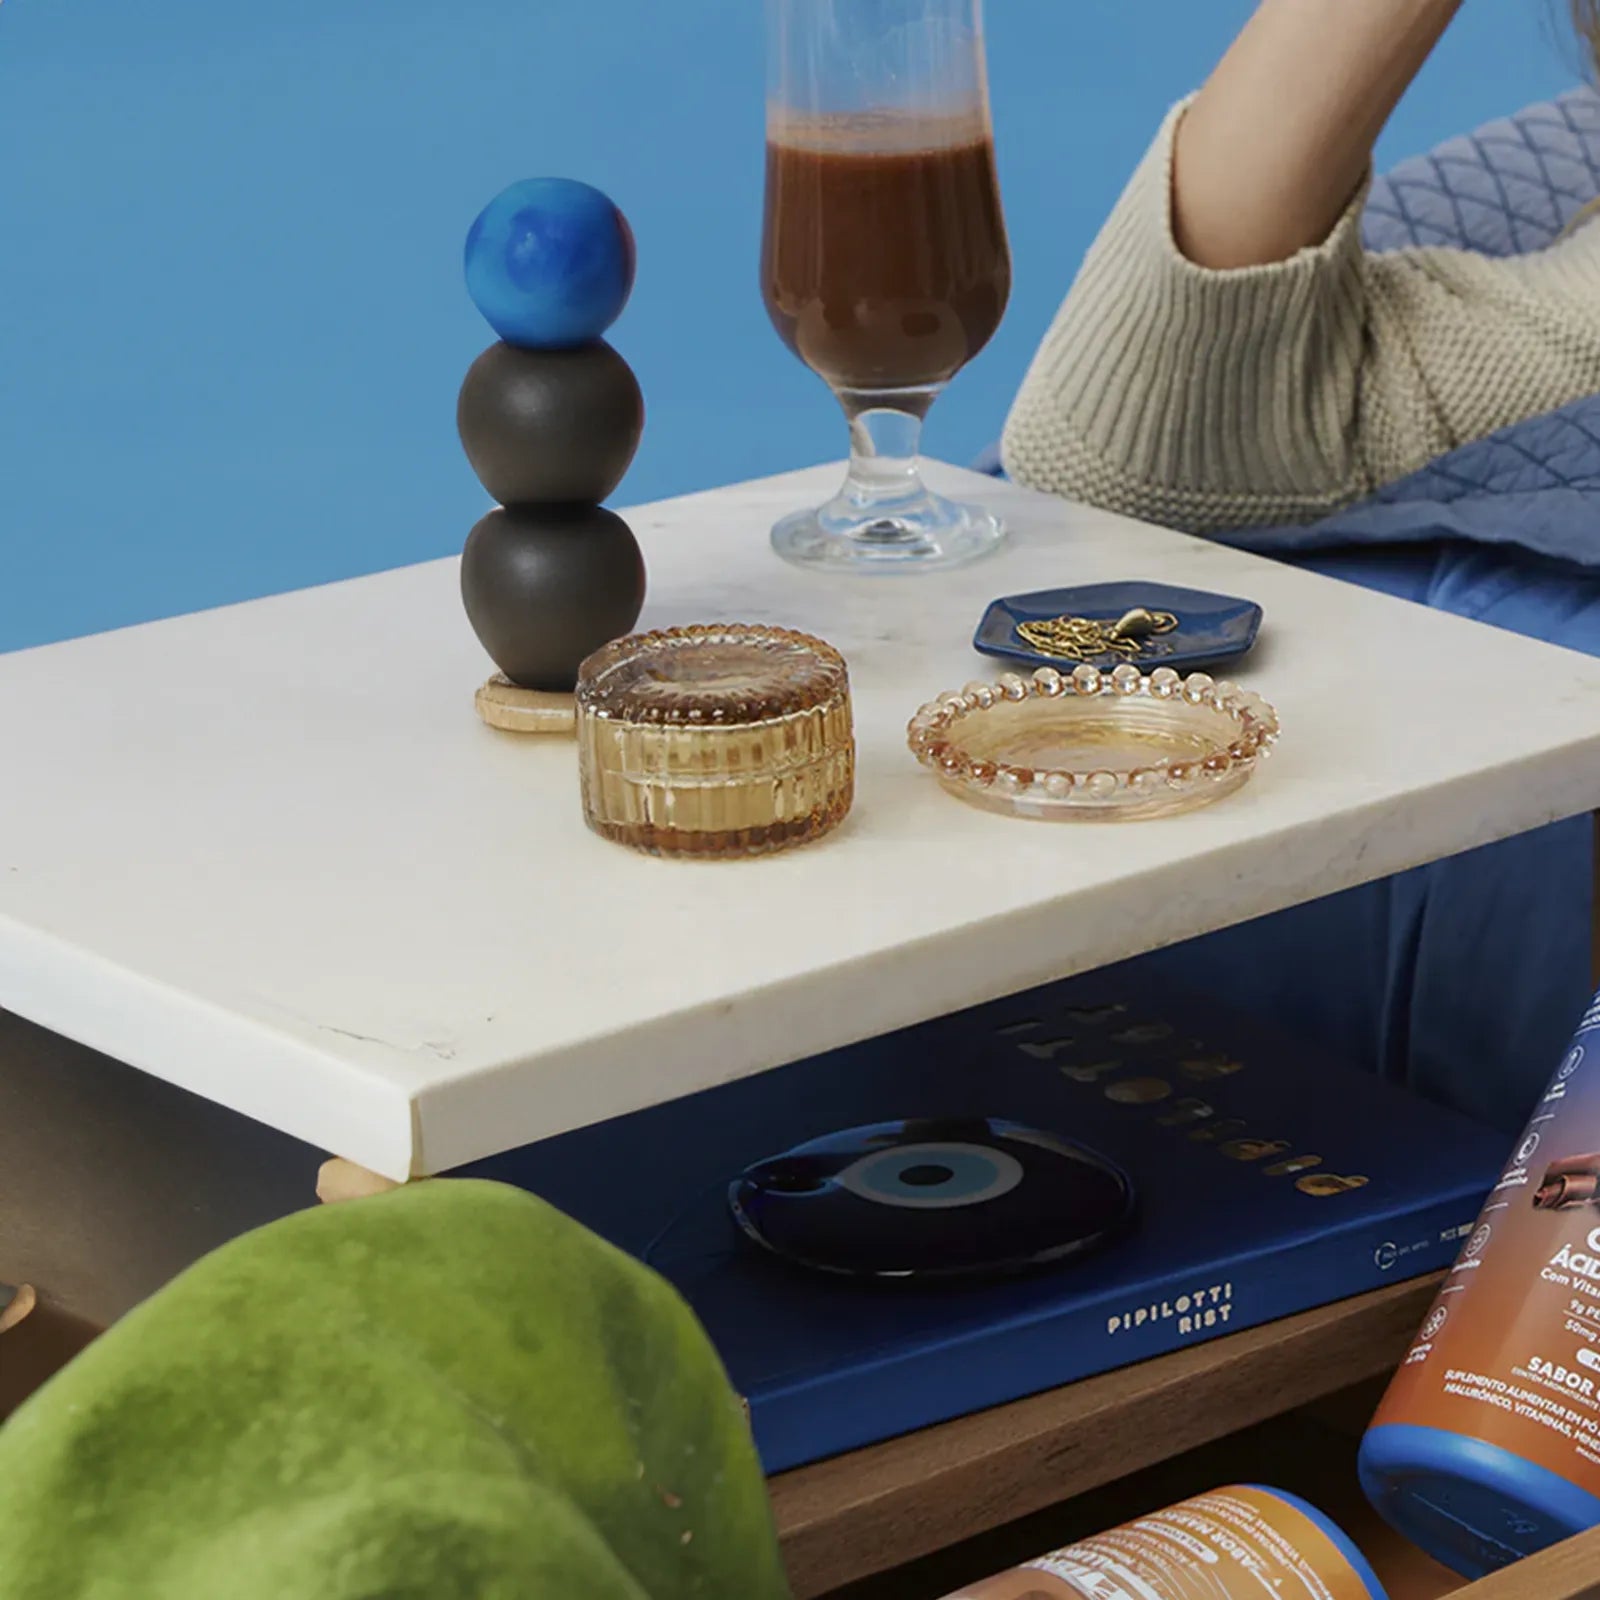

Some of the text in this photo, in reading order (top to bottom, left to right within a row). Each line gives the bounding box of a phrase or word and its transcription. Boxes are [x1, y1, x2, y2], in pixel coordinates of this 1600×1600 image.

[1540, 1266, 1570, 1286] Com
[1107, 1282, 1232, 1335] PIPILOTTI
[1178, 1303, 1232, 1335] RIST
[1569, 1298, 1586, 1315] 9g
[1564, 1318, 1598, 1342] 50mg
[1527, 1355, 1596, 1396] SABOR
[1444, 1368, 1508, 1393] SUPLEMENTO
[1506, 1384, 1567, 1418] ALIMENTAR
[1565, 1409, 1582, 1426] EM
[1581, 1417, 1599, 1433] PÓ
[1514, 1402, 1573, 1439] VITAMINAS,
